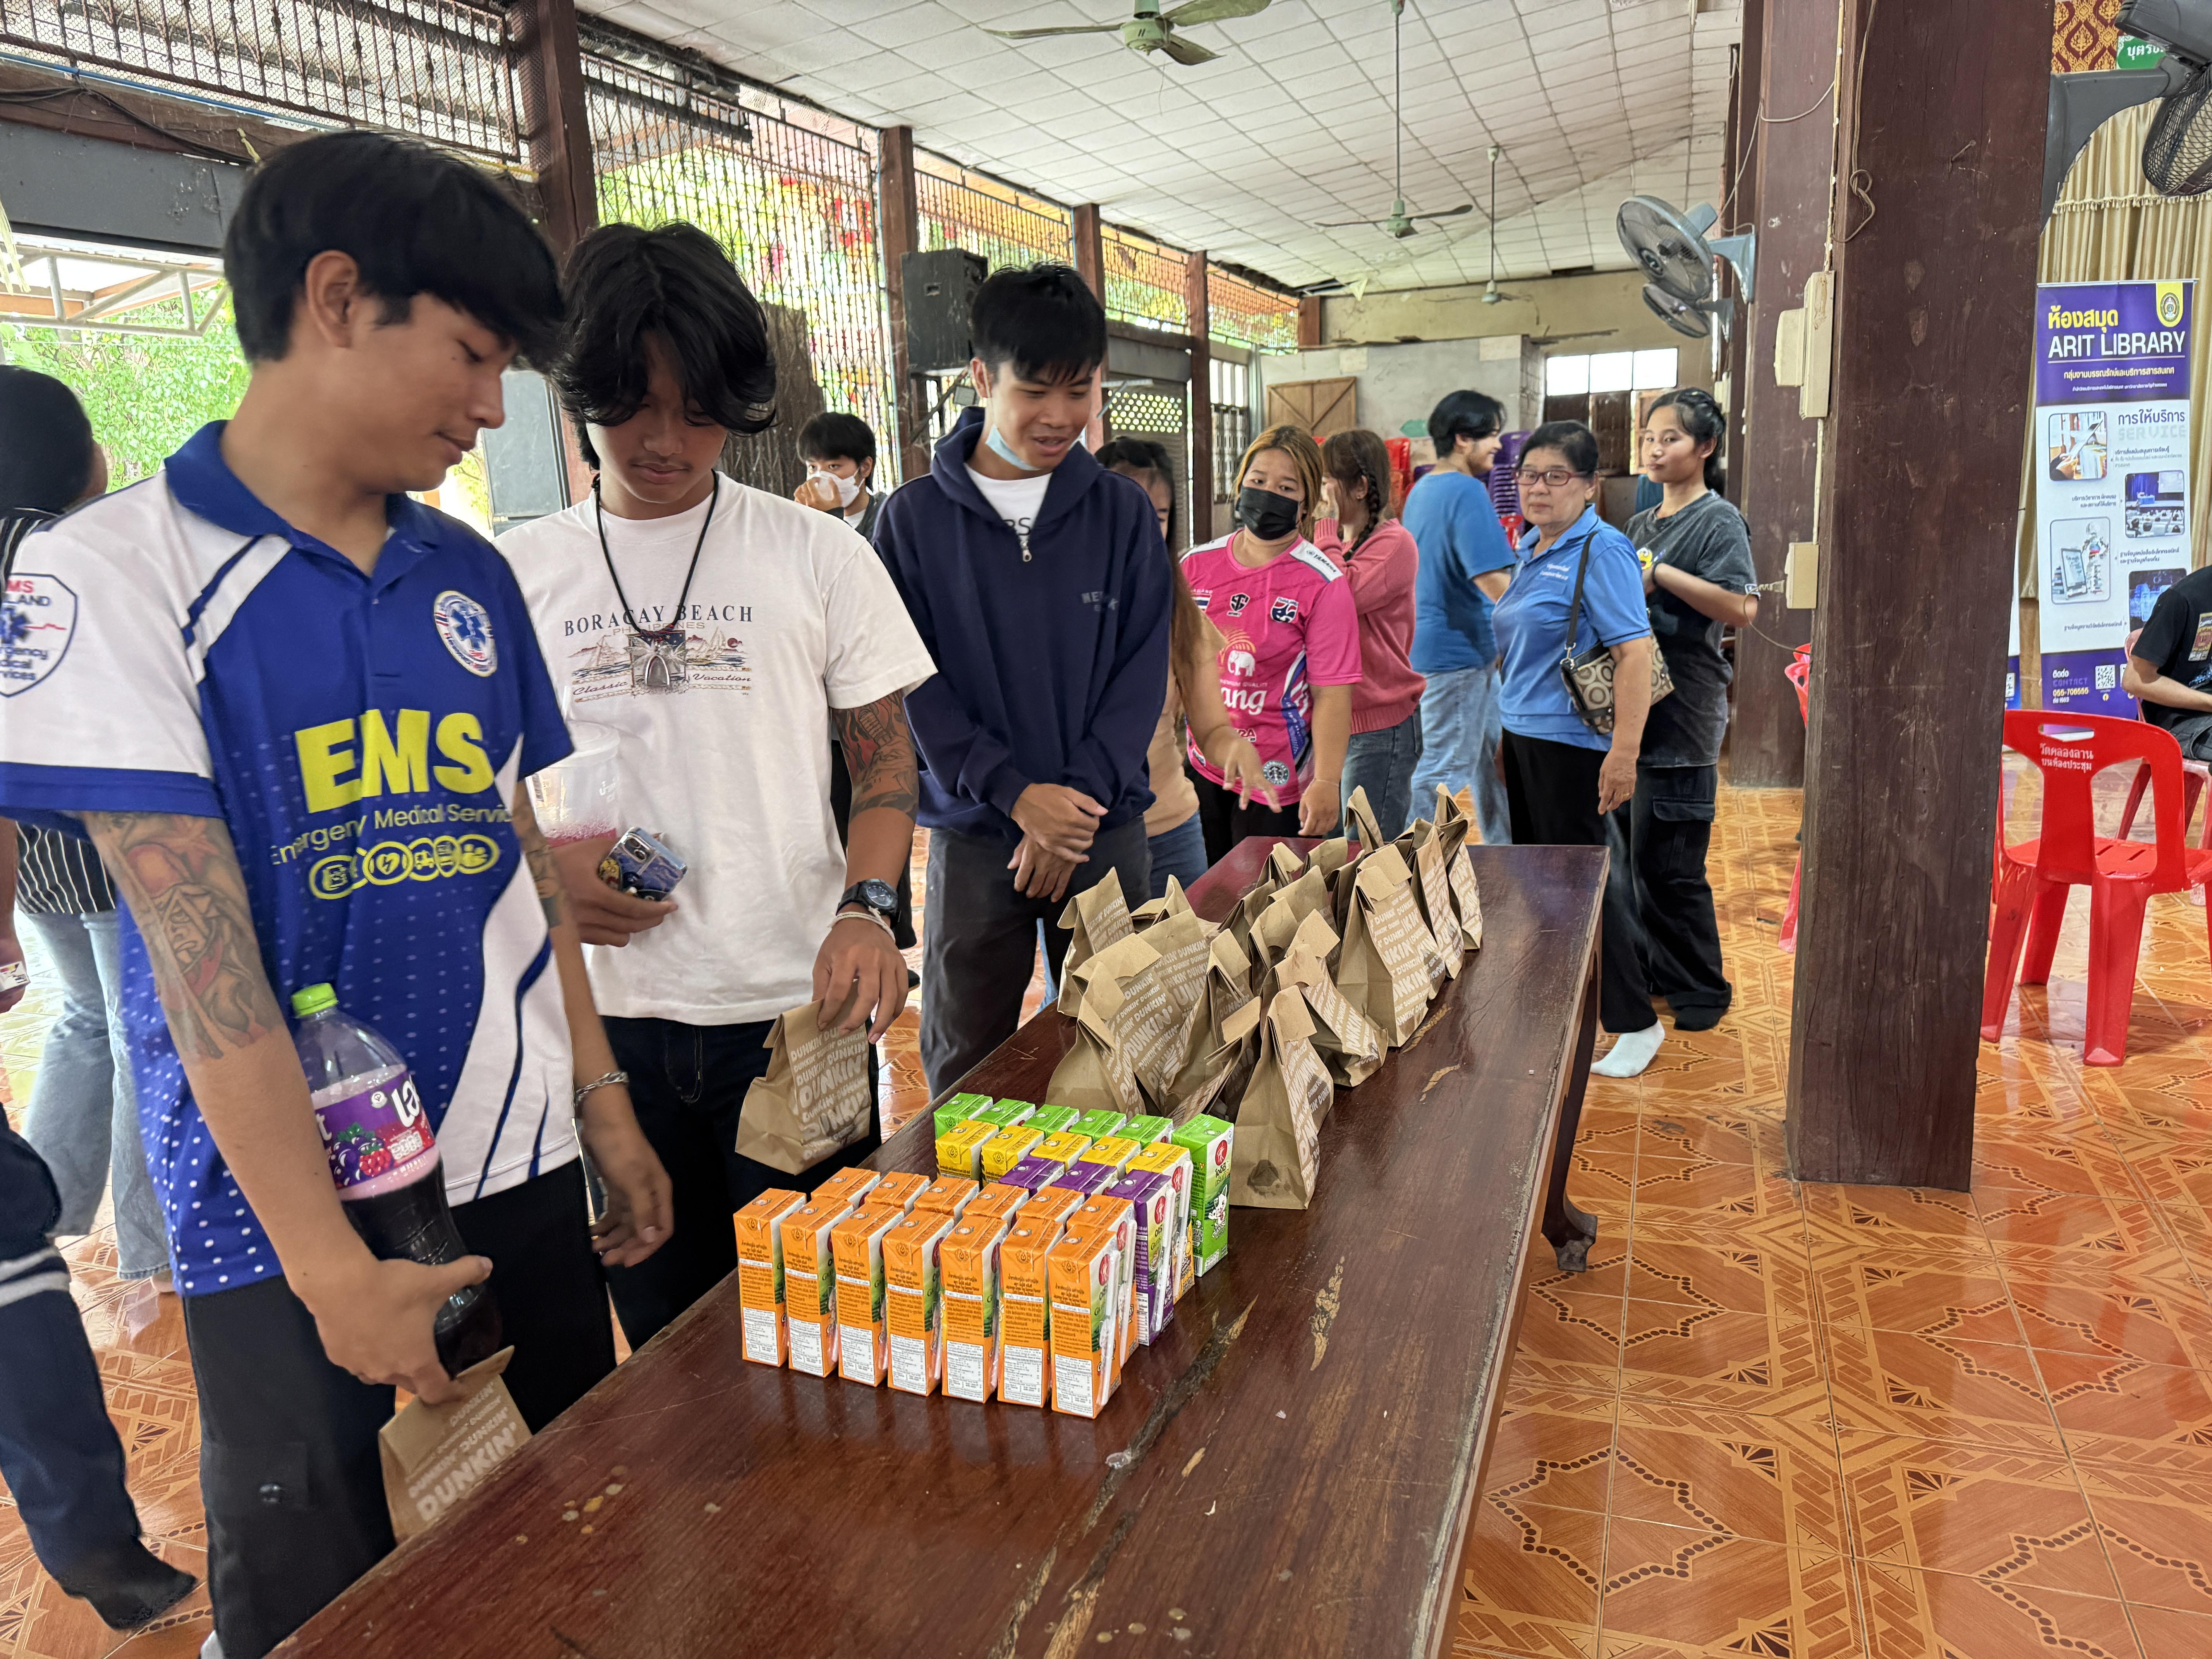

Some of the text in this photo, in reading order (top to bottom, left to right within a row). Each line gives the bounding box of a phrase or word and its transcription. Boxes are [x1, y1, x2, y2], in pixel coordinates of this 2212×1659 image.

[2048, 305, 2119, 333] ห้องสมุด
[2048, 331, 2186, 358] ARIT LIBRARY
[2118, 409, 2185, 425] การให้บริการ
[2118, 424, 2187, 441] SERVICE
[5, 580, 34, 593] MS
[564, 605, 753, 637] BORACAY BEACH
[573, 673, 751, 696] Classic Vacation
[1221, 687, 1268, 715] ang
[294, 709, 494, 814] EMS
[1124, 972, 1154, 1000] DUNKIN'
[1133, 993, 1166, 1022] DUNKIN'
[1125, 1005, 1173, 1059] DUNKIN'
[799, 1052, 868, 1108] DUNKIN'
[416, 1422, 517, 1521] DUNKIN'
